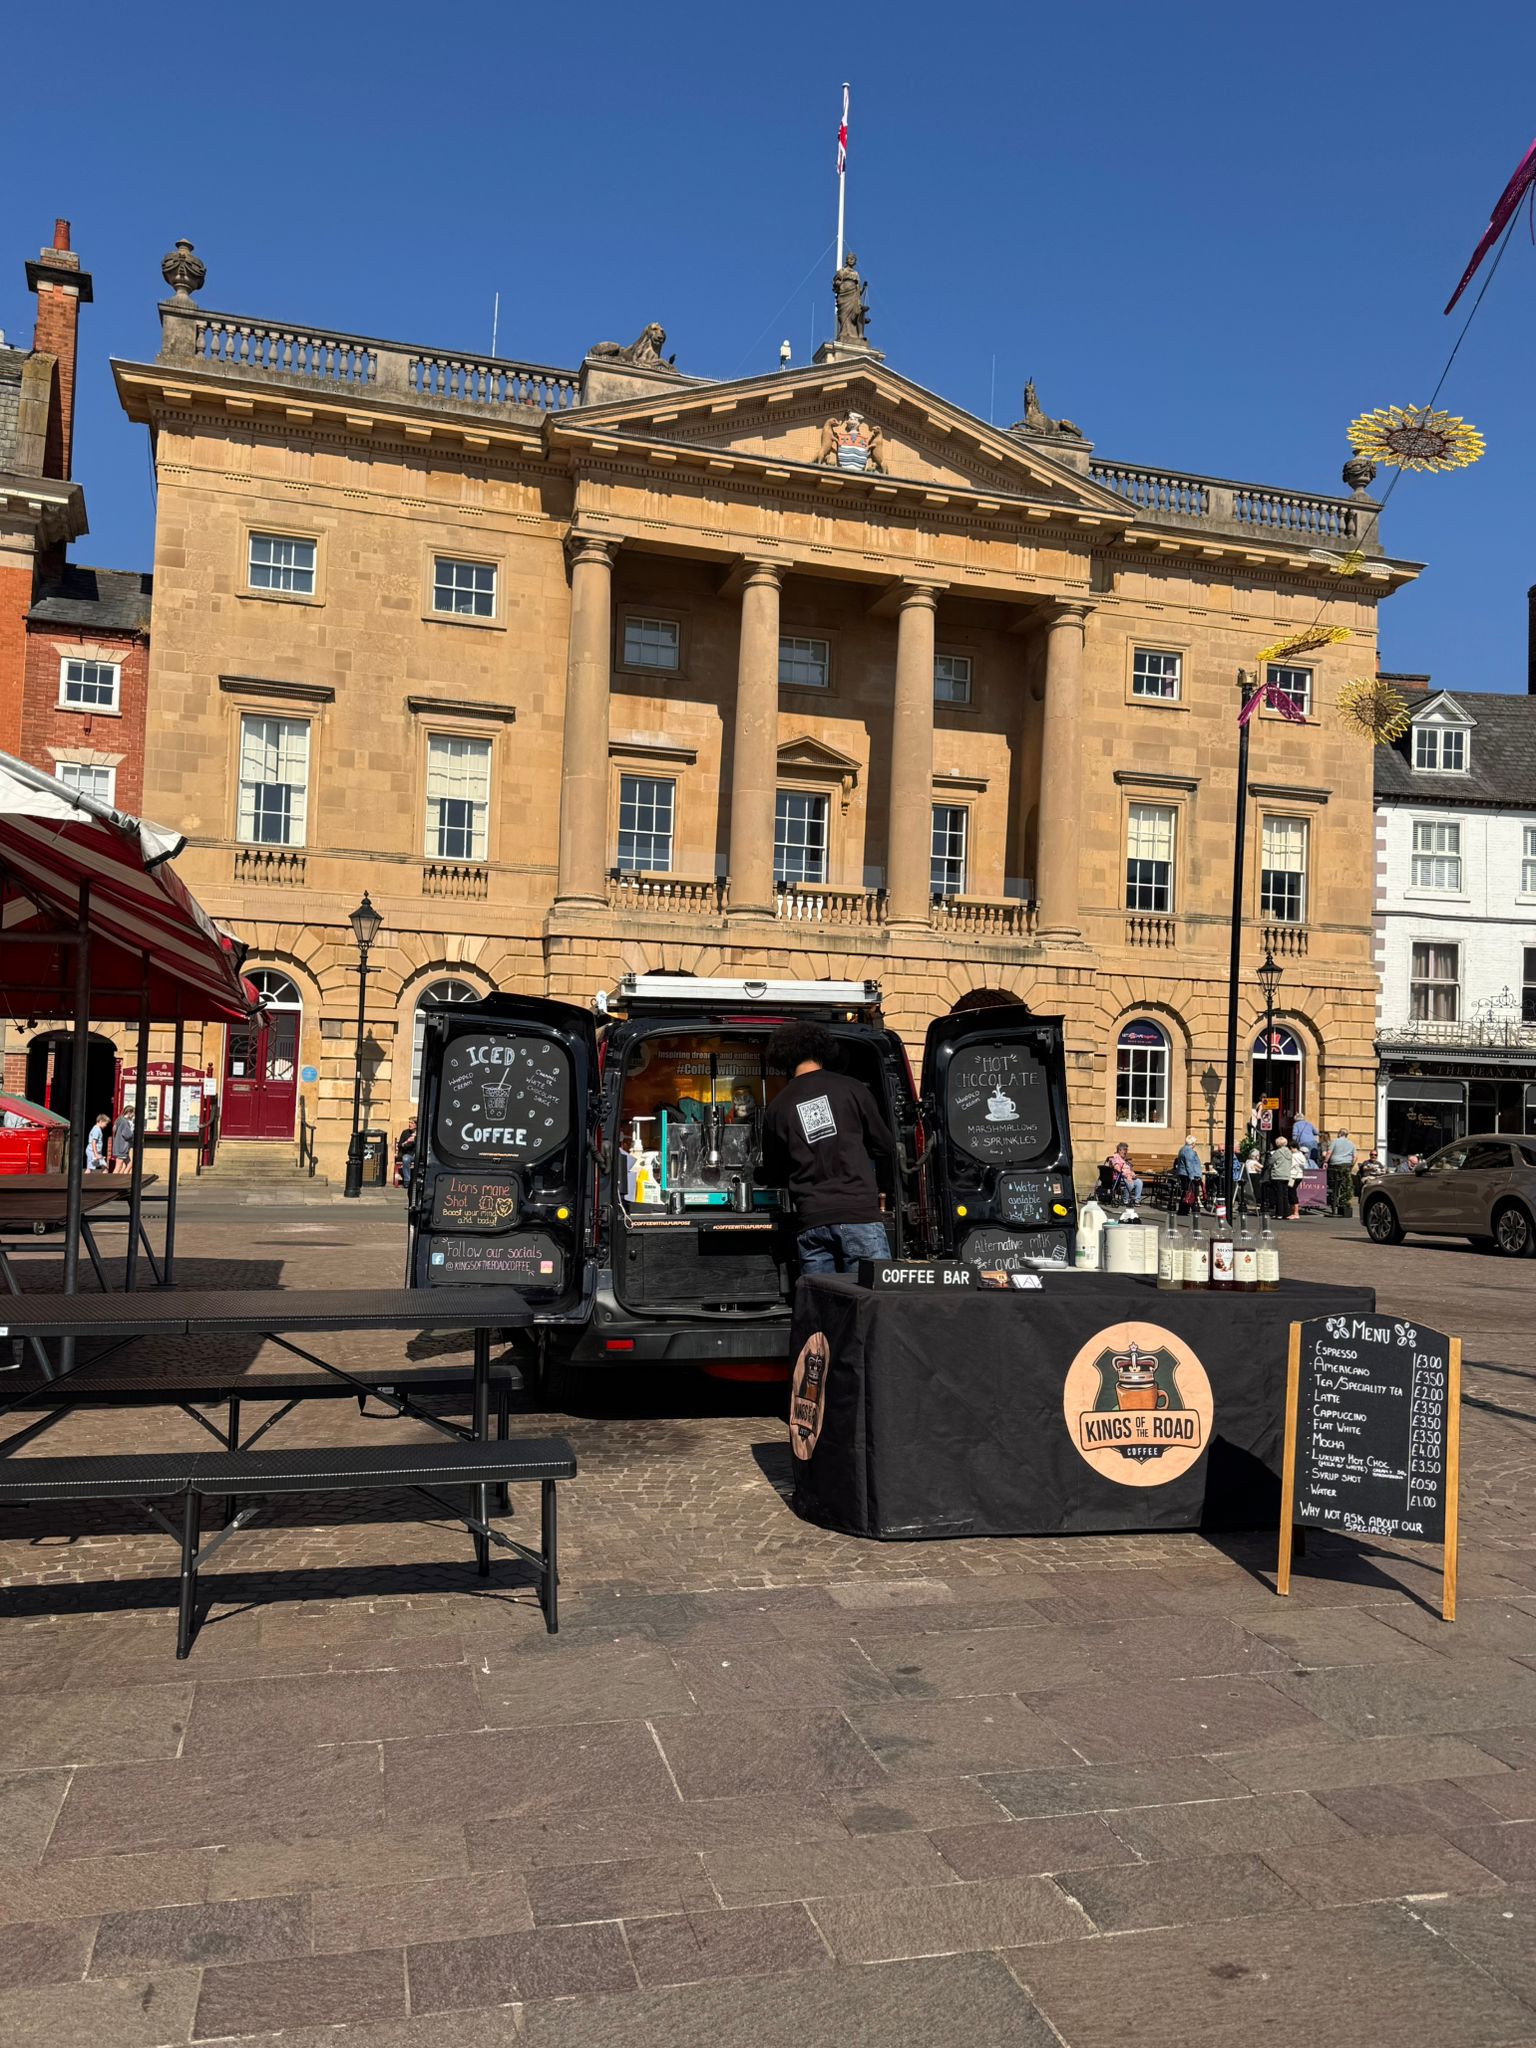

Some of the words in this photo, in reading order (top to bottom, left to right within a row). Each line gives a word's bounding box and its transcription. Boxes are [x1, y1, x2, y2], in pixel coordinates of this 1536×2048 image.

[466, 1046, 515, 1067] ICED
[982, 1056, 1010, 1072] HOT
[956, 1072, 1040, 1088] CHOCOLATE
[461, 1122, 527, 1146] COFFEE
[968, 1124, 1038, 1134] MARSHMALLOWS
[971, 1136, 979, 1147] &
[983, 1136, 1036, 1147] SPRINKLES
[1014, 1180, 1040, 1192] Water
[447, 1241, 482, 1258] Follow
[486, 1248, 504, 1258] our
[508, 1245, 542, 1259] socials
[882, 1269, 935, 1284] COFFEE
[944, 1270, 970, 1285] BAR
[1352, 1320, 1390, 1344] MENU
[1315, 1340, 1358, 1359] ESPRESSO
[1416, 1354, 1442, 1370] £3.00
[1314, 1356, 1370, 1376] AMERICANO
[1314, 1389, 1340, 1404] LATTE
[1414, 1400, 1442, 1416] £3.50
[1390, 1386, 1403, 1397] TEA
[1414, 1386, 1444, 1401] £2.00
[1136, 1416, 1146, 1428] OF
[1313, 1404, 1367, 1422] CAPPUCCINO
[1412, 1416, 1442, 1430] £3.50
[1085, 1417, 1132, 1442] KINGS
[1136, 1428, 1148, 1438] THE
[1152, 1416, 1194, 1440] ROAD
[1313, 1418, 1334, 1431] FLAT
[1336, 1422, 1361, 1435] WHITE
[1412, 1430, 1442, 1444] £3.50
[1127, 1447, 1158, 1456] COFFEE
[1312, 1432, 1345, 1450] MOCHA
[1412, 1444, 1440, 1458] £4.00
[1312, 1448, 1346, 1464] LUXURY
[1348, 1453, 1364, 1466] HOT
[1366, 1456, 1390, 1469] CHOC
[1412, 1459, 1441, 1474] £3.50
[1312, 1468, 1339, 1481] SYRUP
[1341, 1474, 1362, 1484] SHOT
[1310, 1483, 1337, 1497] WATER
[1410, 1496, 1436, 1508] £1.00
[1300, 1501, 1320, 1517] WHY
[1324, 1509, 1342, 1520] NOT
[1344, 1512, 1364, 1525] ASK
[1368, 1516, 1399, 1530] ABOUT
[1401, 1521, 1424, 1534] OUR
